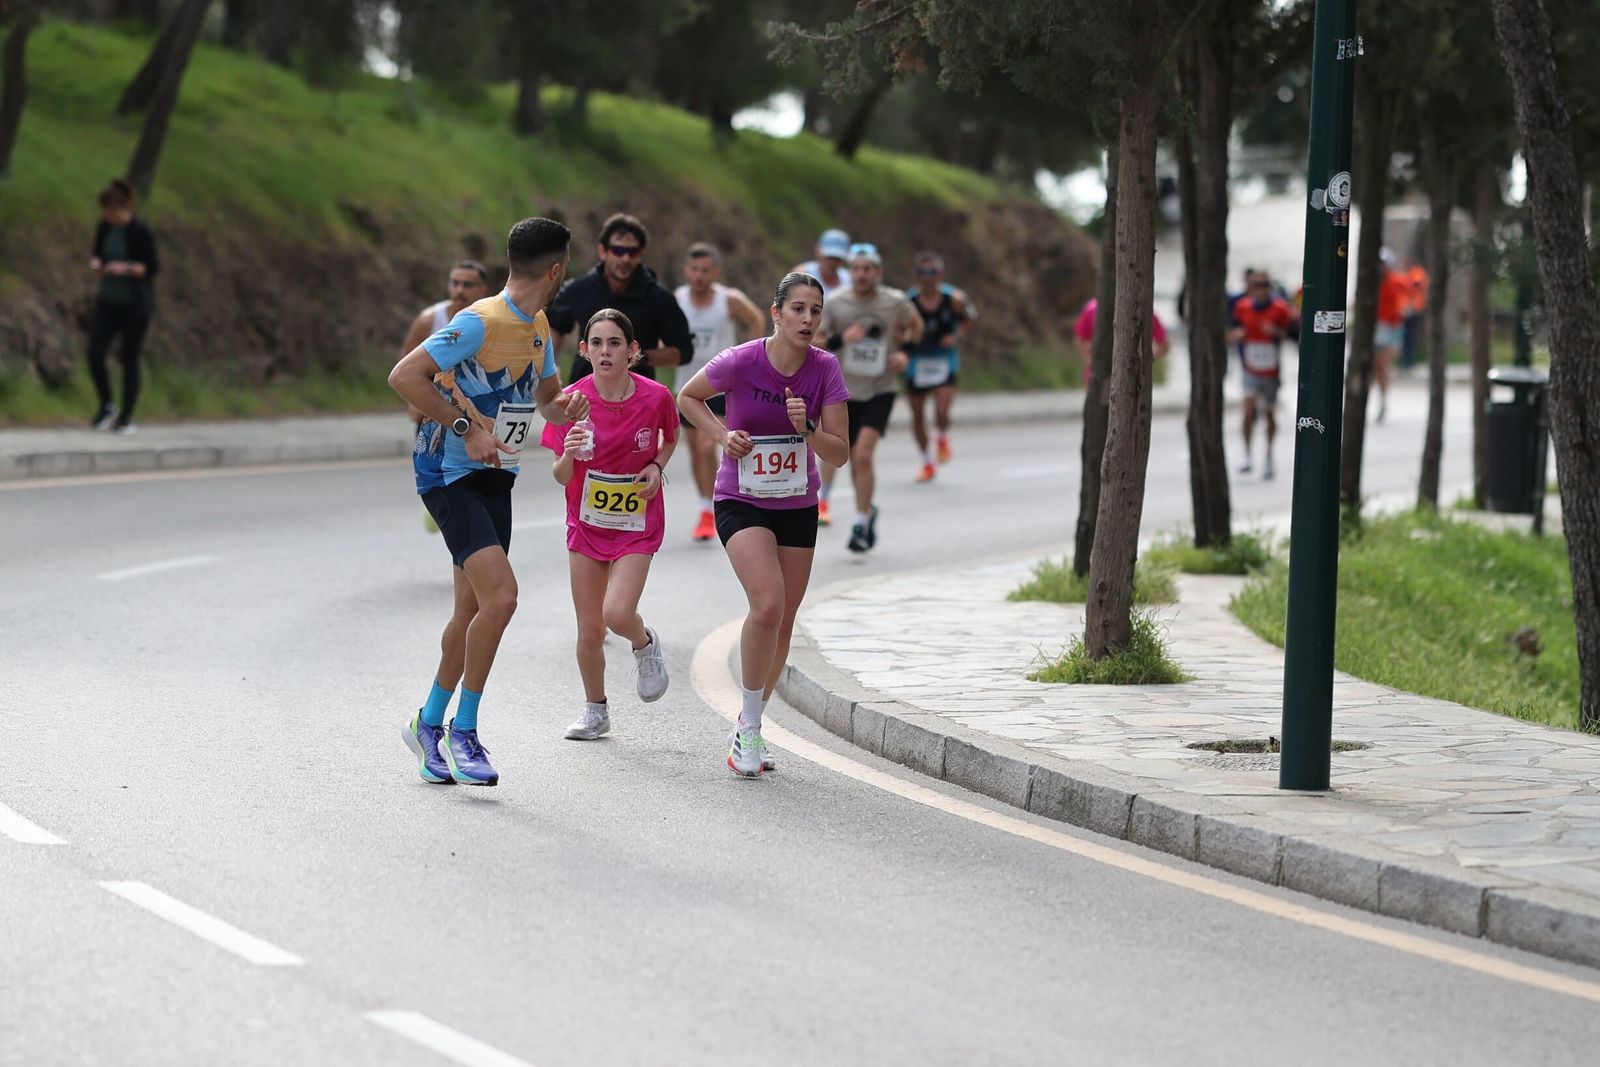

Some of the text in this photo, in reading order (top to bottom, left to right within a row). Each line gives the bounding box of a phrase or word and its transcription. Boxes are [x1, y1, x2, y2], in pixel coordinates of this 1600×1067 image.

[503, 421, 531, 444] 73
[753, 451, 798, 475] 194
[593, 490, 639, 512] 926
